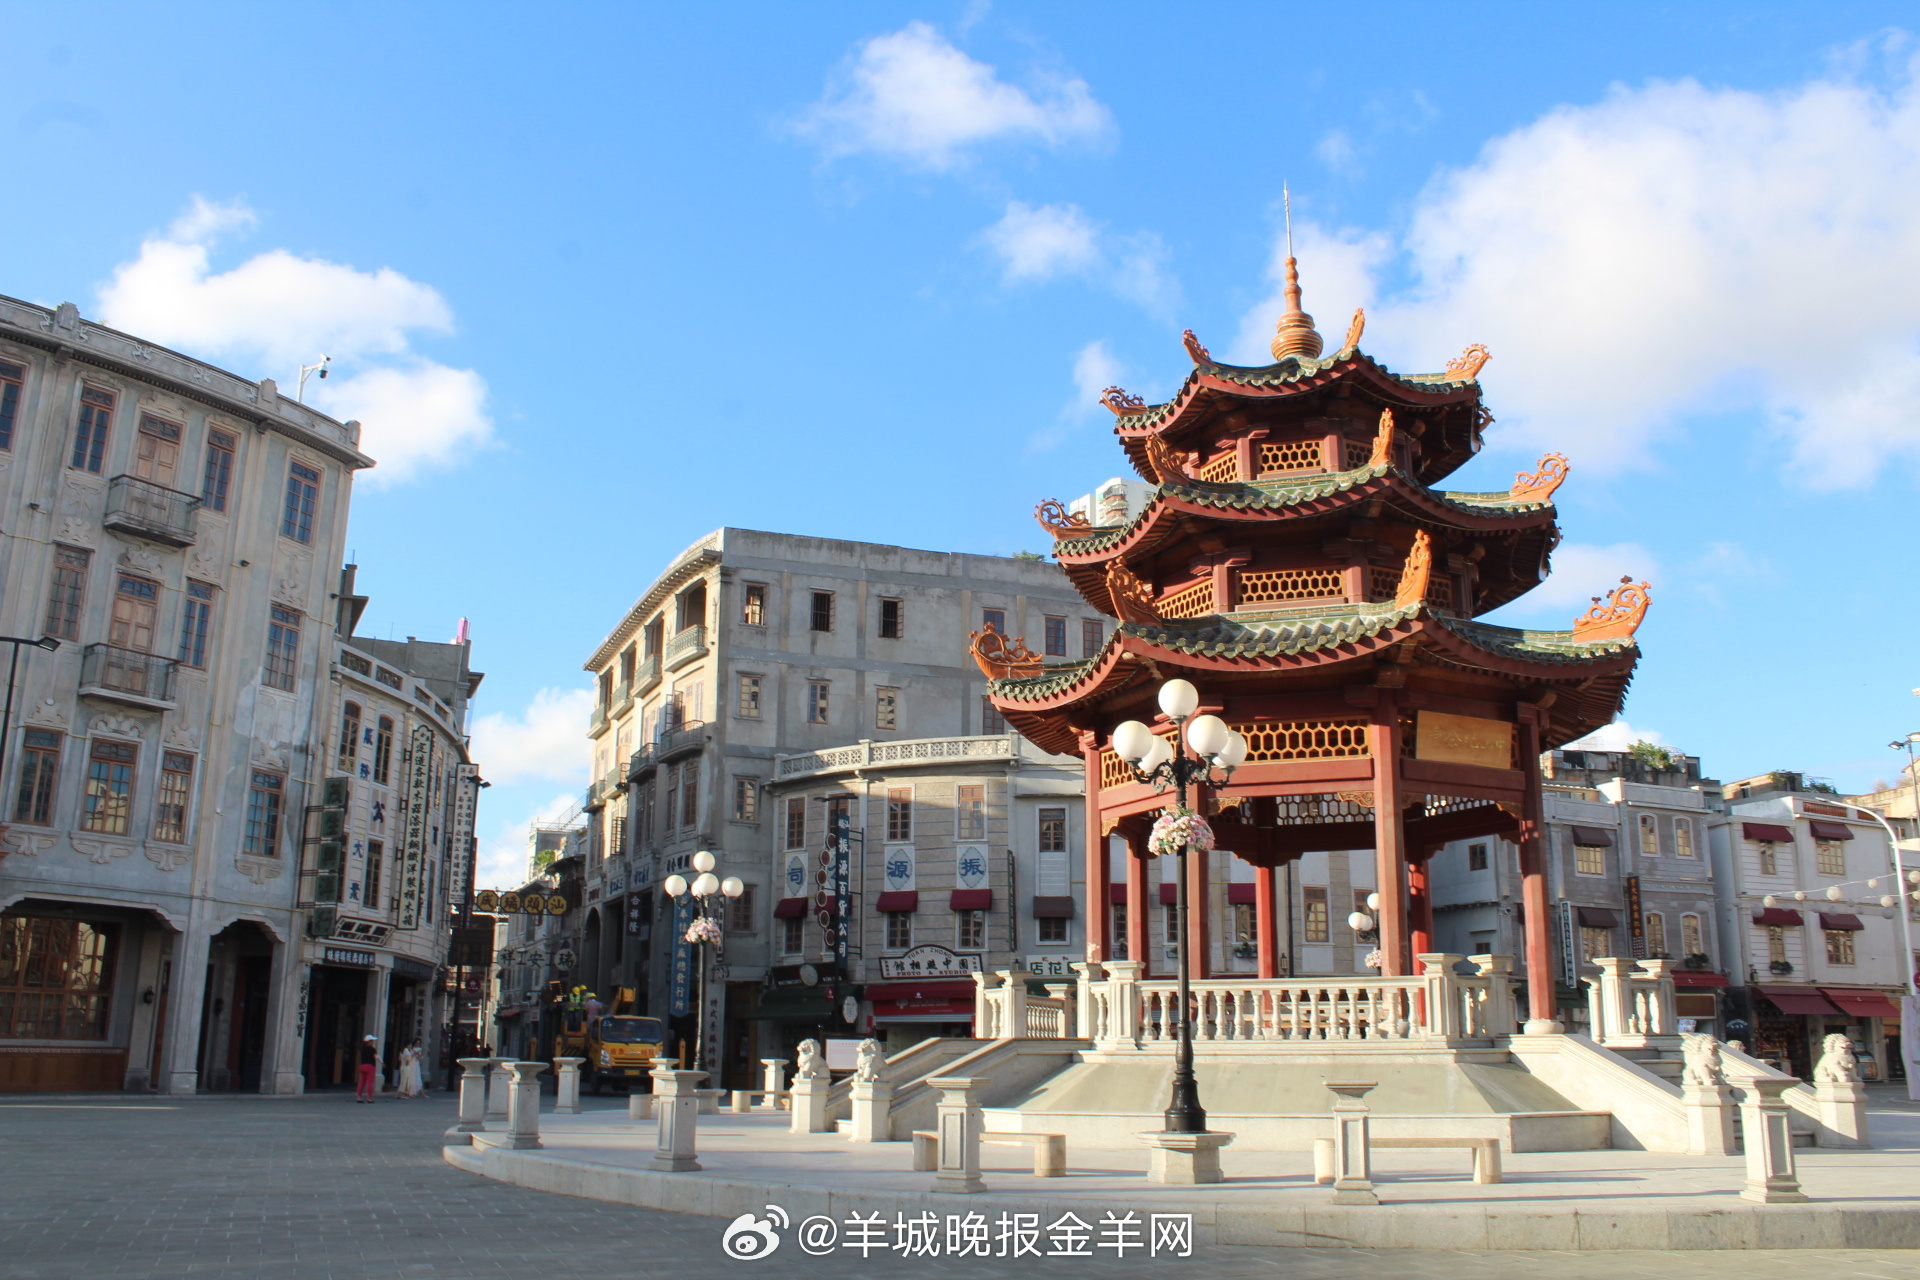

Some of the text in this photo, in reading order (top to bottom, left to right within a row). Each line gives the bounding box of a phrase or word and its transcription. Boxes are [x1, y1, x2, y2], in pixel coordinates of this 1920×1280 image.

[838, 838, 849, 958] 振源百貨公司
[907, 947, 953, 960] YUAN ZHONG
